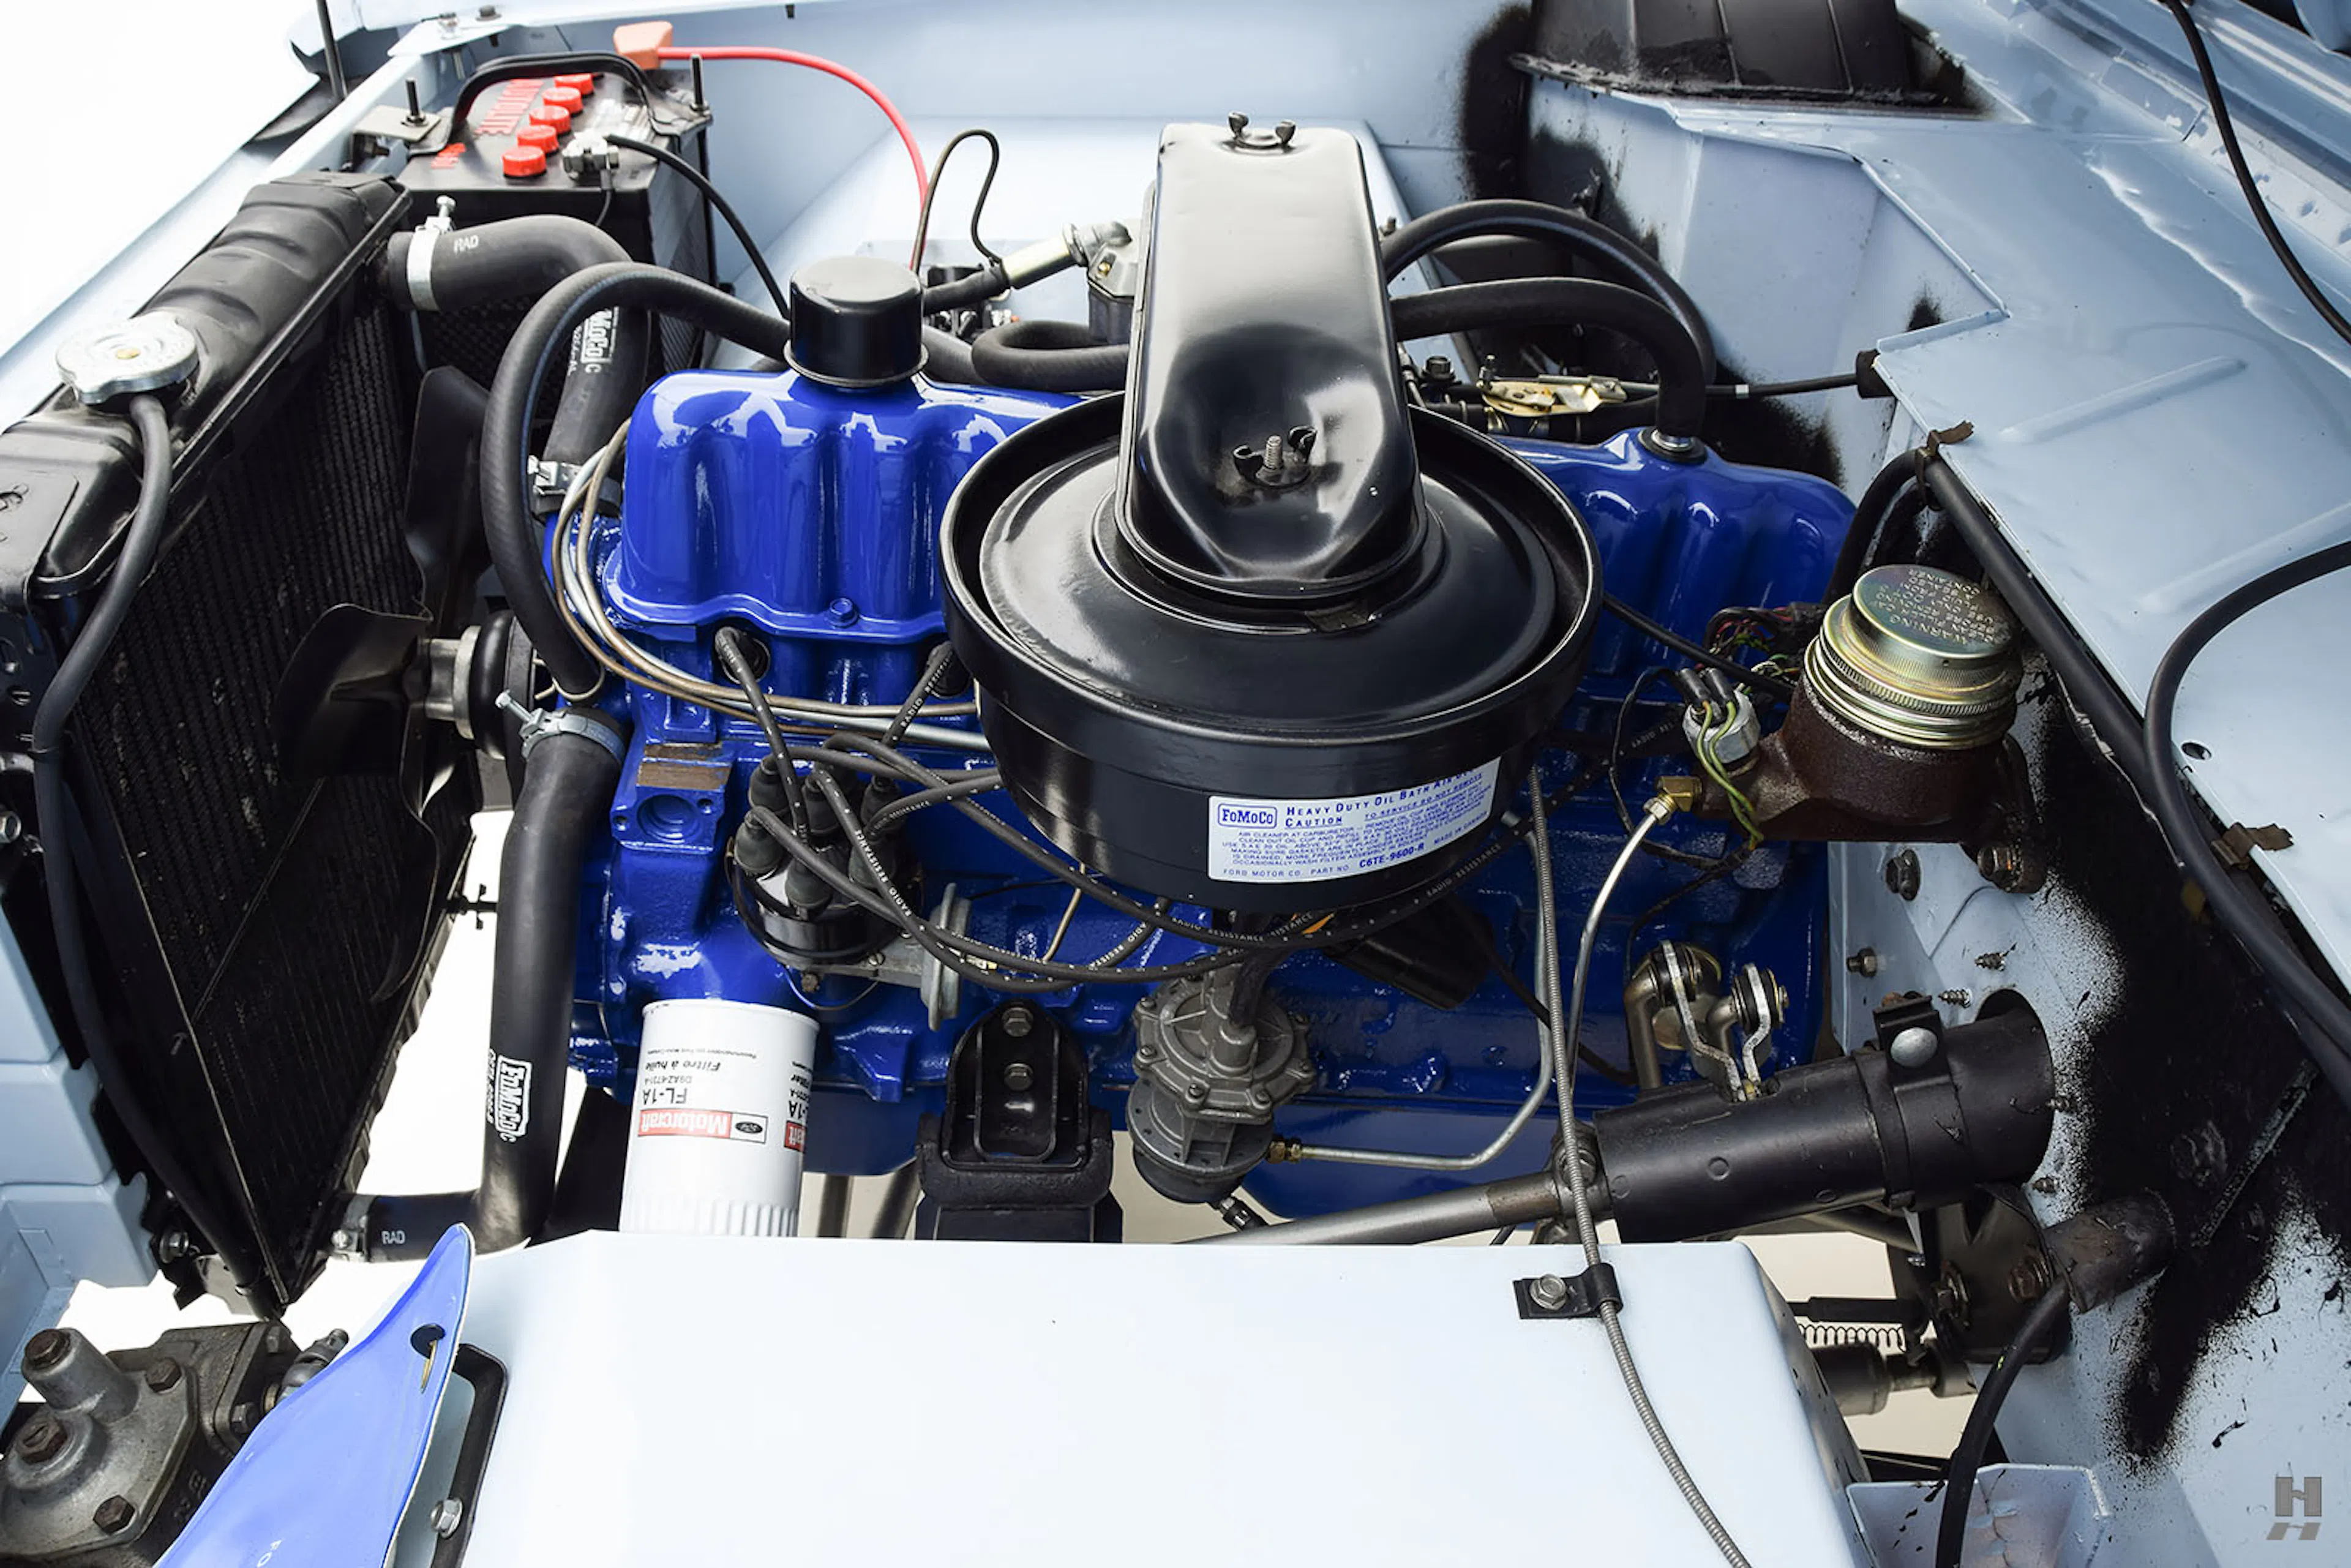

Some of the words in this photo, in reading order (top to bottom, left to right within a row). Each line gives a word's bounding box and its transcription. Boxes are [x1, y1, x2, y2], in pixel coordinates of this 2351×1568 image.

[454, 234, 479, 254] RAD
[1888, 614, 1967, 645] WARNING
[1287, 806, 1330, 816] HEAVY
[1336, 801, 1370, 813] DUTY
[1375, 797, 1394, 806] OIL
[1400, 786, 1430, 800] BATH
[1222, 808, 1273, 824] FoMoCo
[1286, 817, 1342, 827] CAUTION
[855, 829, 888, 883] RESISTANCE
[888, 887, 912, 917] RADIO
[1128, 922, 1146, 942] ADIO
[642, 1087, 688, 1105] FL-1A
[642, 1111, 729, 1136] Motorcraft
[381, 1230, 407, 1245] RAD
